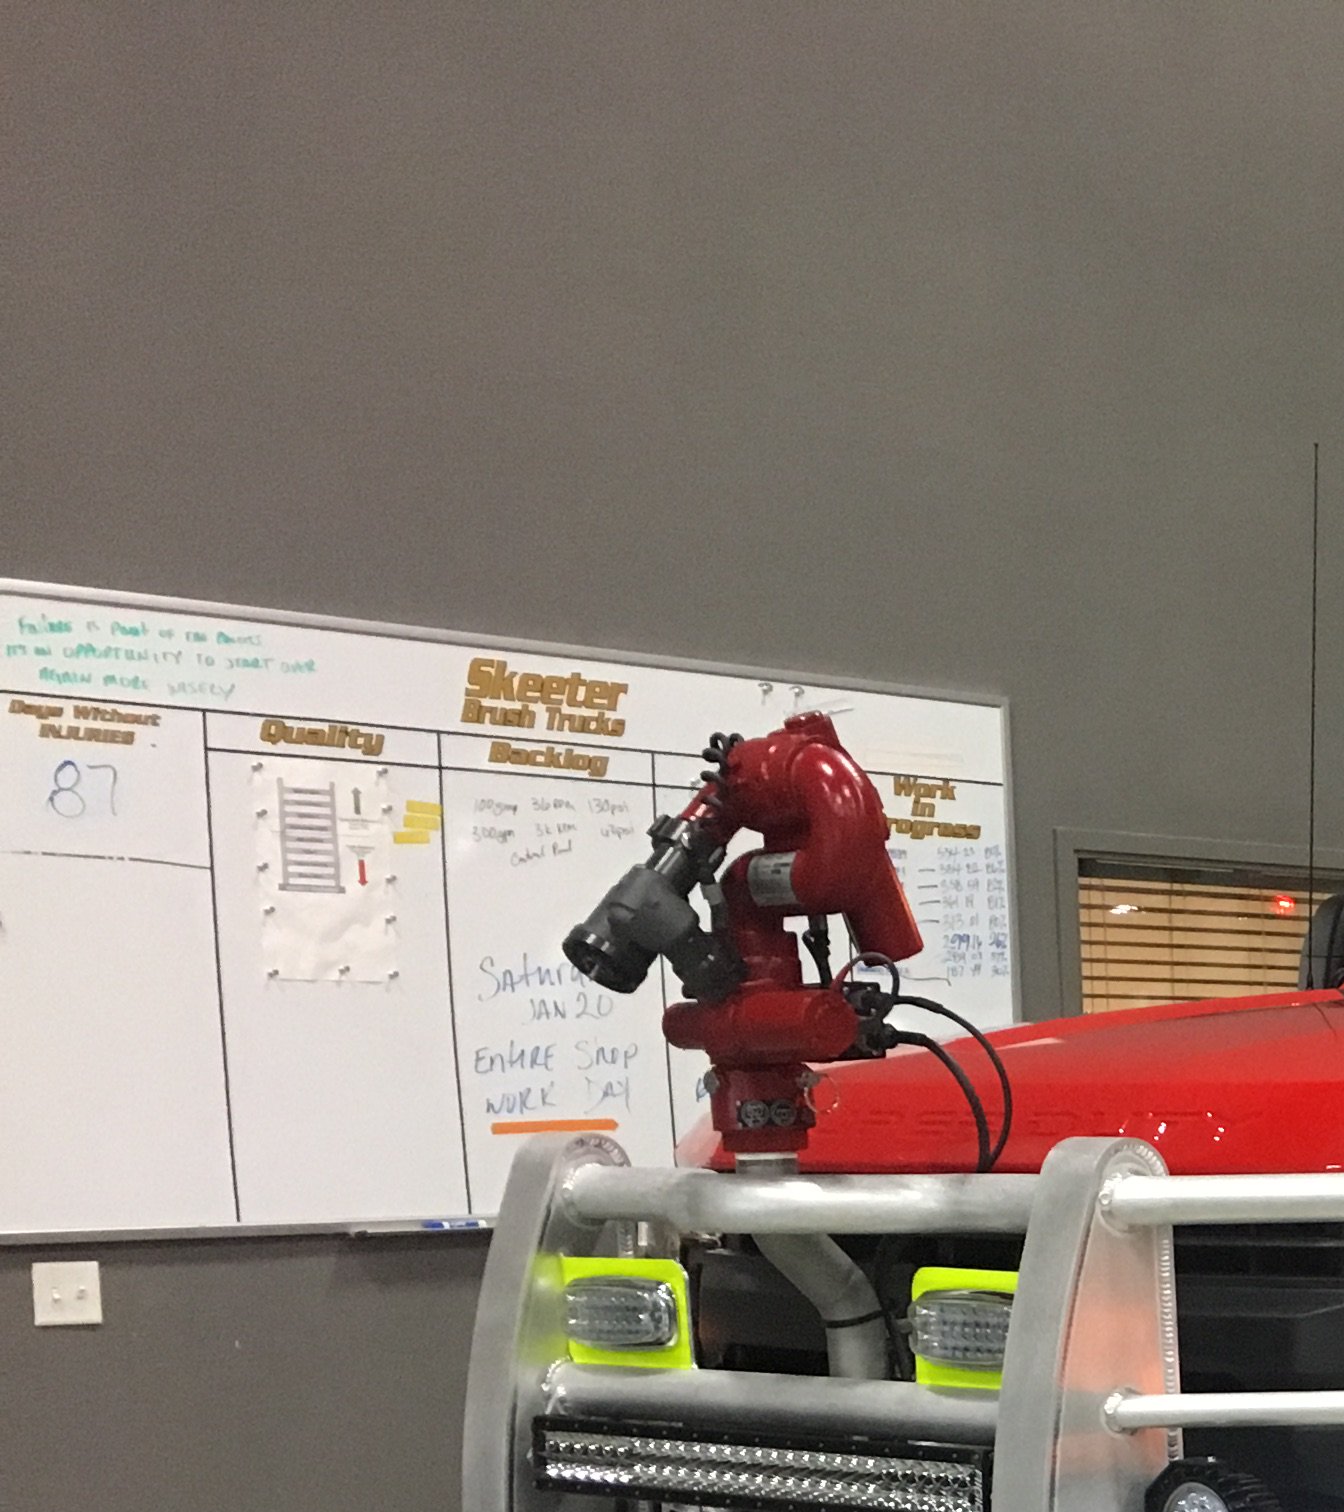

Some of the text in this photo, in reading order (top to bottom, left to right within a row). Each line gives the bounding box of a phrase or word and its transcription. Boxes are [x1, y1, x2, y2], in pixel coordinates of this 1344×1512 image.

[465, 657, 628, 711] Skeeter
[39, 723, 135, 745] INJURIES
[461, 698, 626, 737] Brush Trucks
[260, 719, 385, 756] Quality
[488, 741, 610, 778] Backlog
[49, 760, 117, 817] 87
[893, 775, 956, 800] Work
[911, 793, 935, 817] in
[887, 817, 981, 840] rogress
[522, 992, 613, 1025] JAN 20
